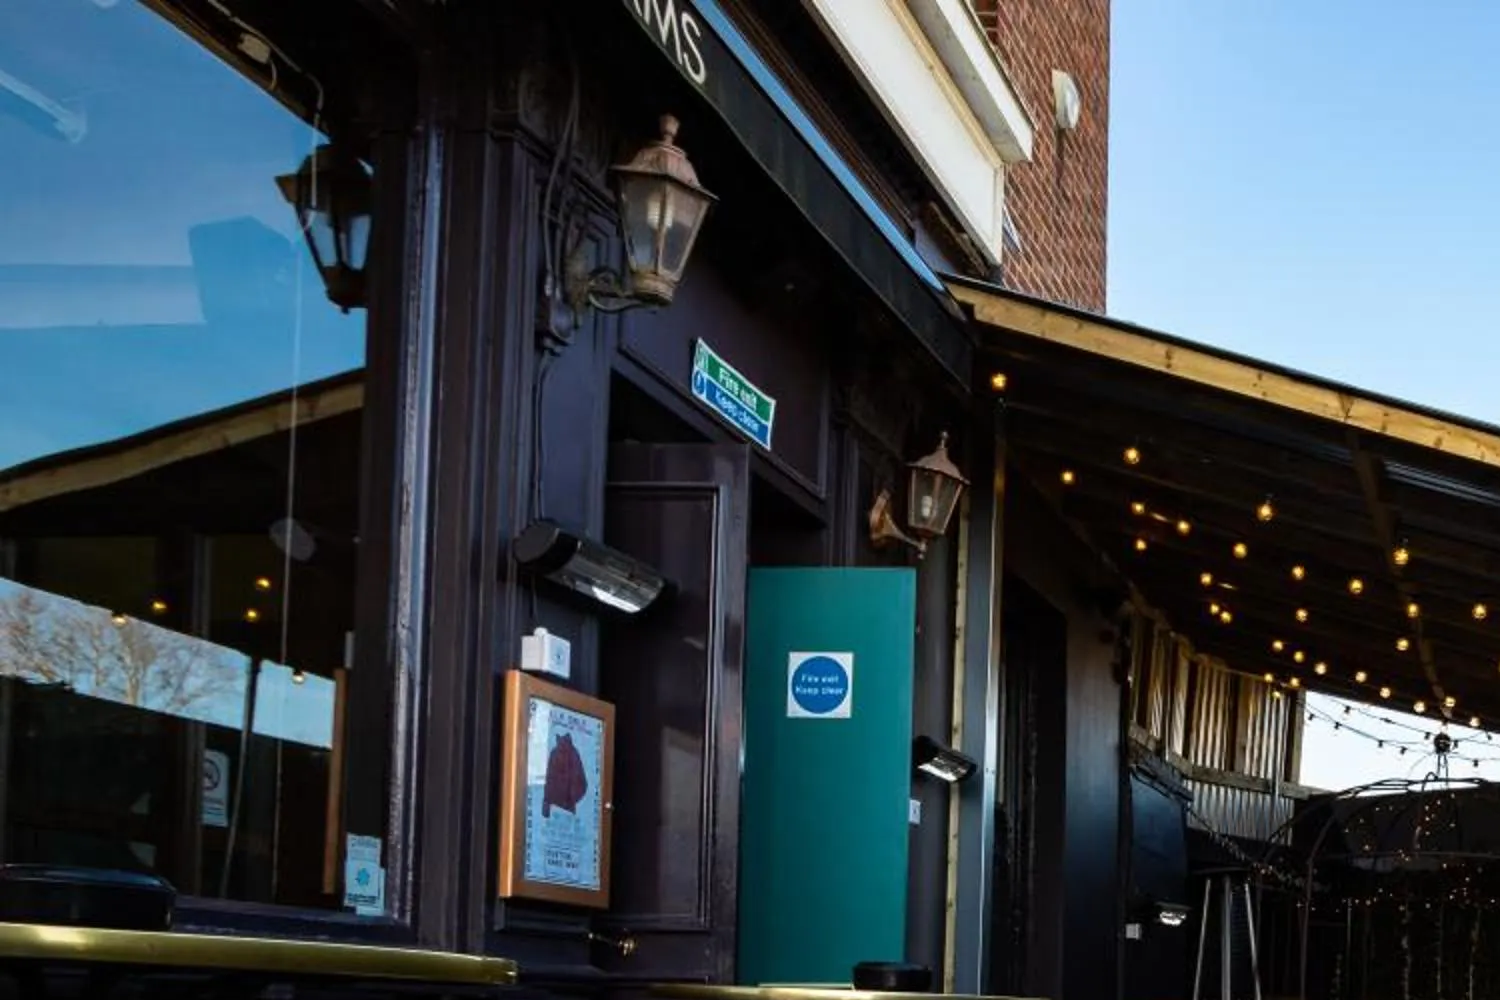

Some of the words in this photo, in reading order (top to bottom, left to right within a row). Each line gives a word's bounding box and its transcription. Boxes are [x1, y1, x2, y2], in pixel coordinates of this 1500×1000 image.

[632, 0, 706, 84] MS
[715, 389, 738, 417] Keep
[738, 409, 760, 433] clear
[719, 367, 739, 397] Fire
[740, 388, 757, 412] exit
[795, 684, 819, 696] Keep
[801, 672, 819, 683] Fire
[821, 672, 839, 684] exit
